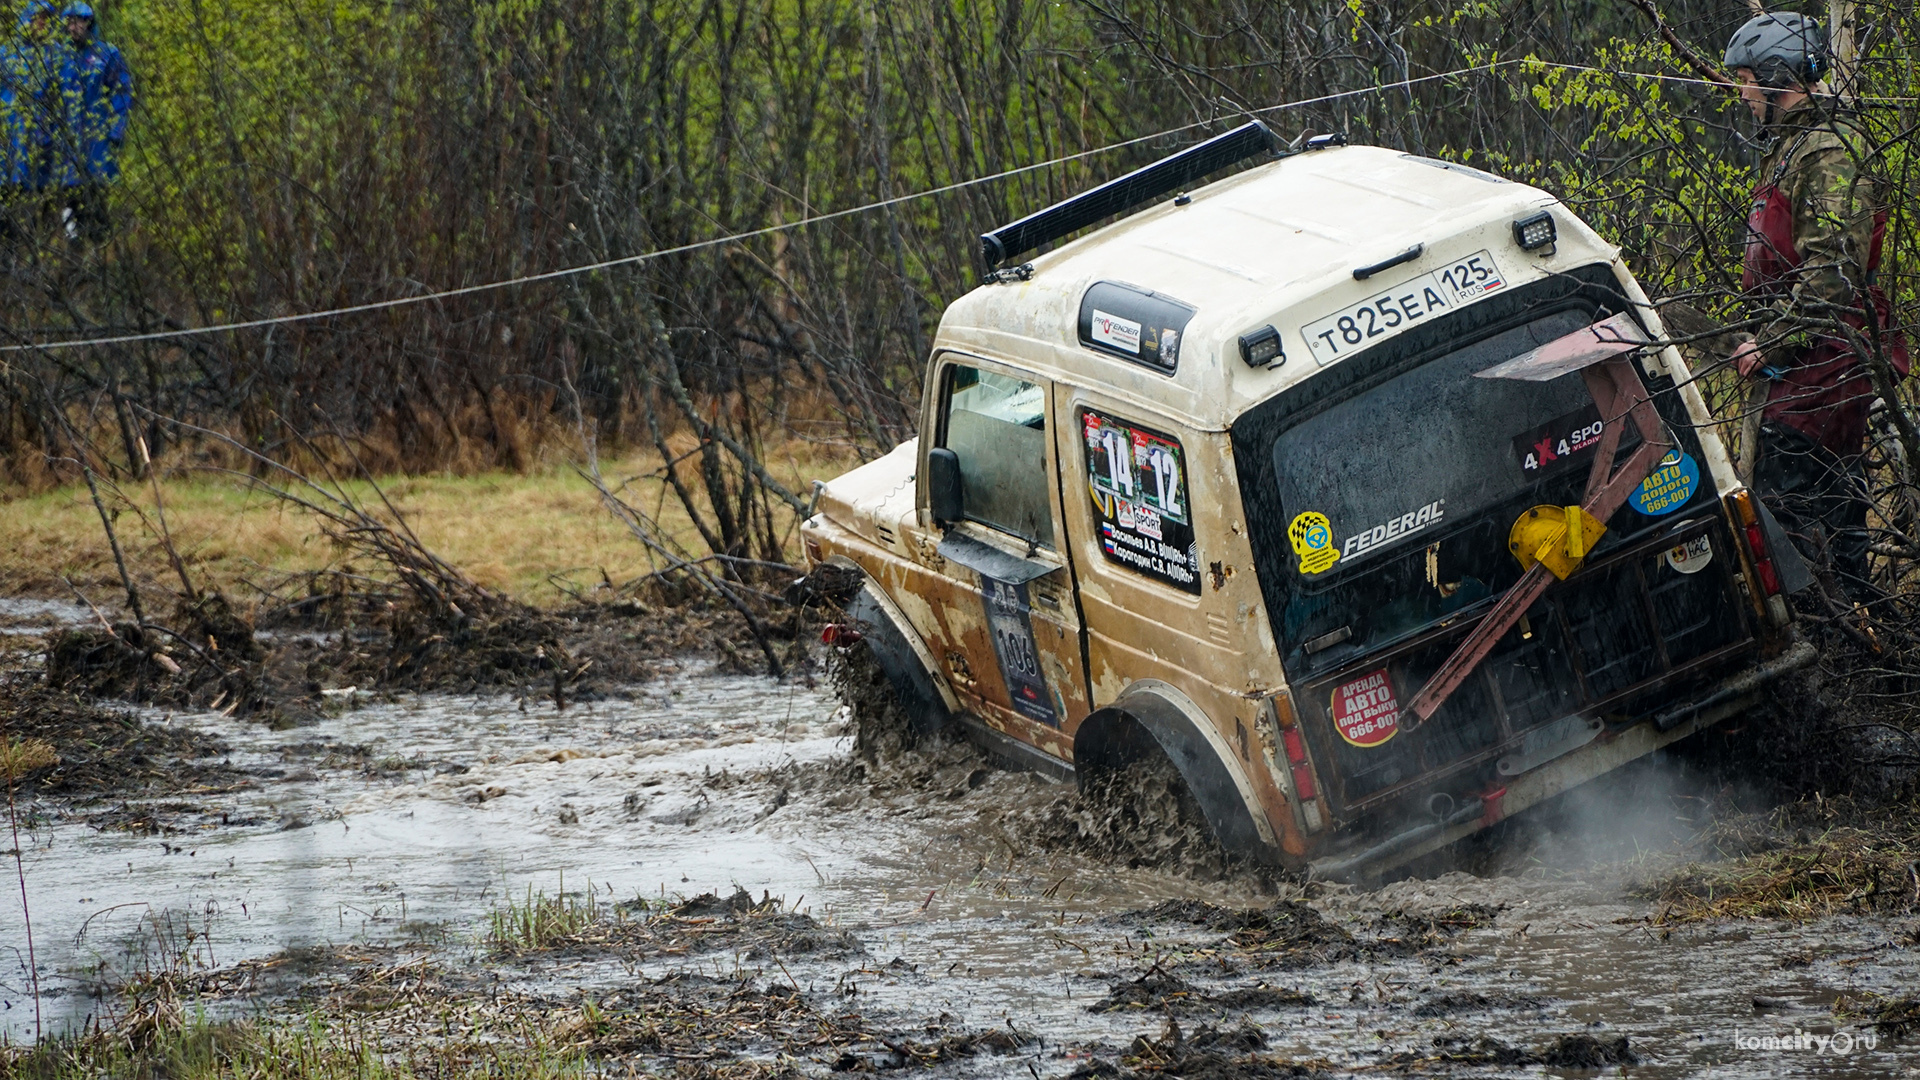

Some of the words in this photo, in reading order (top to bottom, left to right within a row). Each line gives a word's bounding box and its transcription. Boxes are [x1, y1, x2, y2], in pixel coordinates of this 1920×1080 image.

[1441, 257, 1489, 291] 125
[1459, 284, 1484, 300] RUS
[1094, 316, 1139, 336] PROFENDER
[1571, 420, 1603, 445] SPO
[1573, 435, 1602, 452] VLADIV
[1103, 431, 1133, 497] 14
[1150, 450, 1182, 516] 12
[1643, 465, 1681, 492] АВТО
[1647, 487, 1690, 513] 666-007
[1136, 512, 1160, 531] SPORT
[1343, 501, 1444, 557] FEDERAL
[1110, 526, 1144, 550] Васильев
[1113, 540, 1151, 569] Карагодин
[998, 628, 1037, 677] 106
[1342, 673, 1385, 698] АРЕНДА
[1344, 685, 1391, 715] АВТО
[1348, 711, 1399, 739] 666-007
